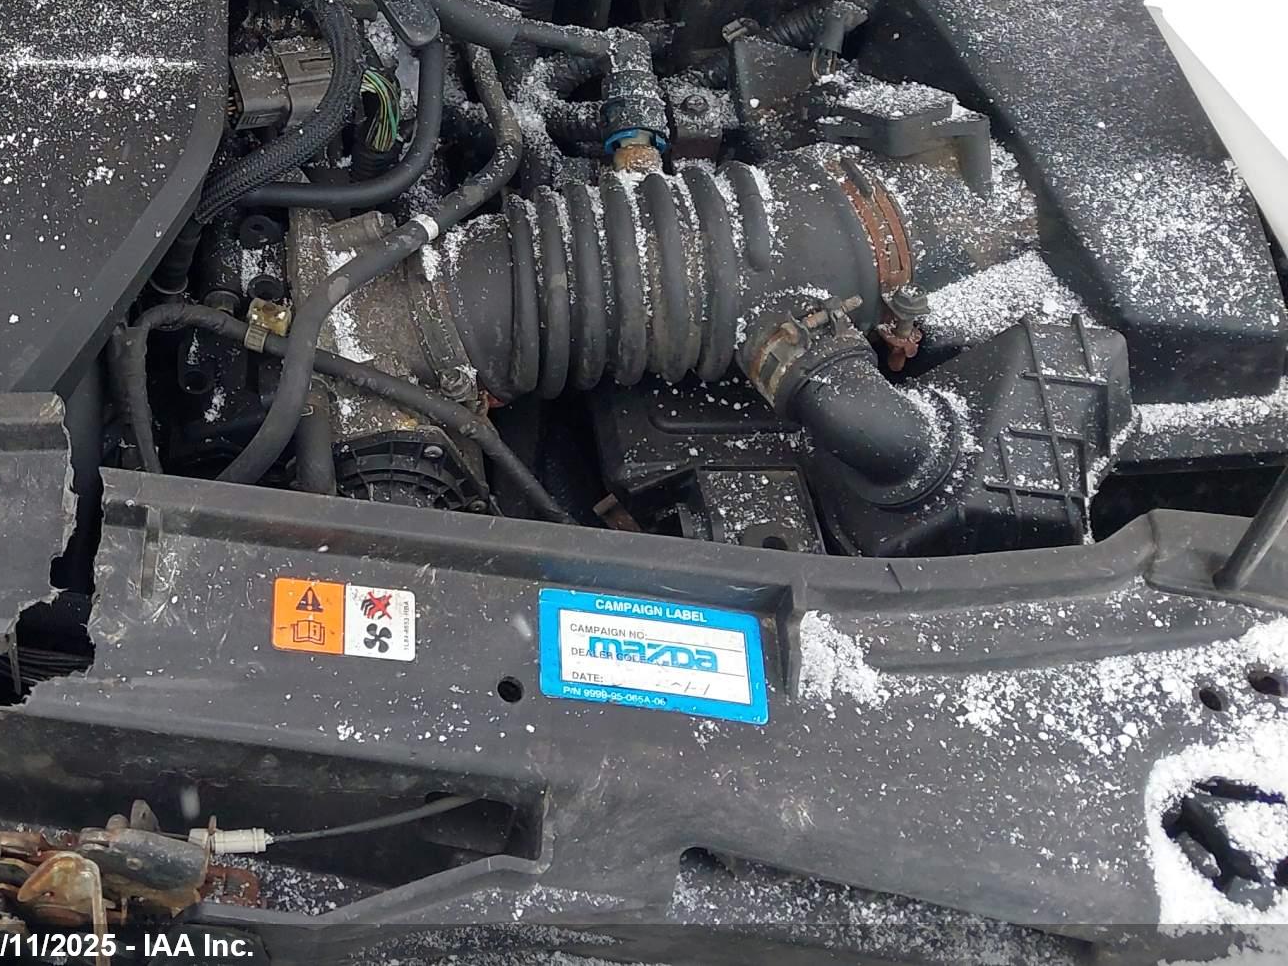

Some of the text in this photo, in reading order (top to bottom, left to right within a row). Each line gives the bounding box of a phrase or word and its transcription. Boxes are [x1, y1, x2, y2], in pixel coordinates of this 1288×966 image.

[595, 599, 708, 623] CAMPAIGN LABEL
[569, 623, 626, 638] CAMPAIGN
[570, 646, 614, 661] DEALER
[571, 671, 604, 683] DATE:
[562, 685, 582, 696] P/N
